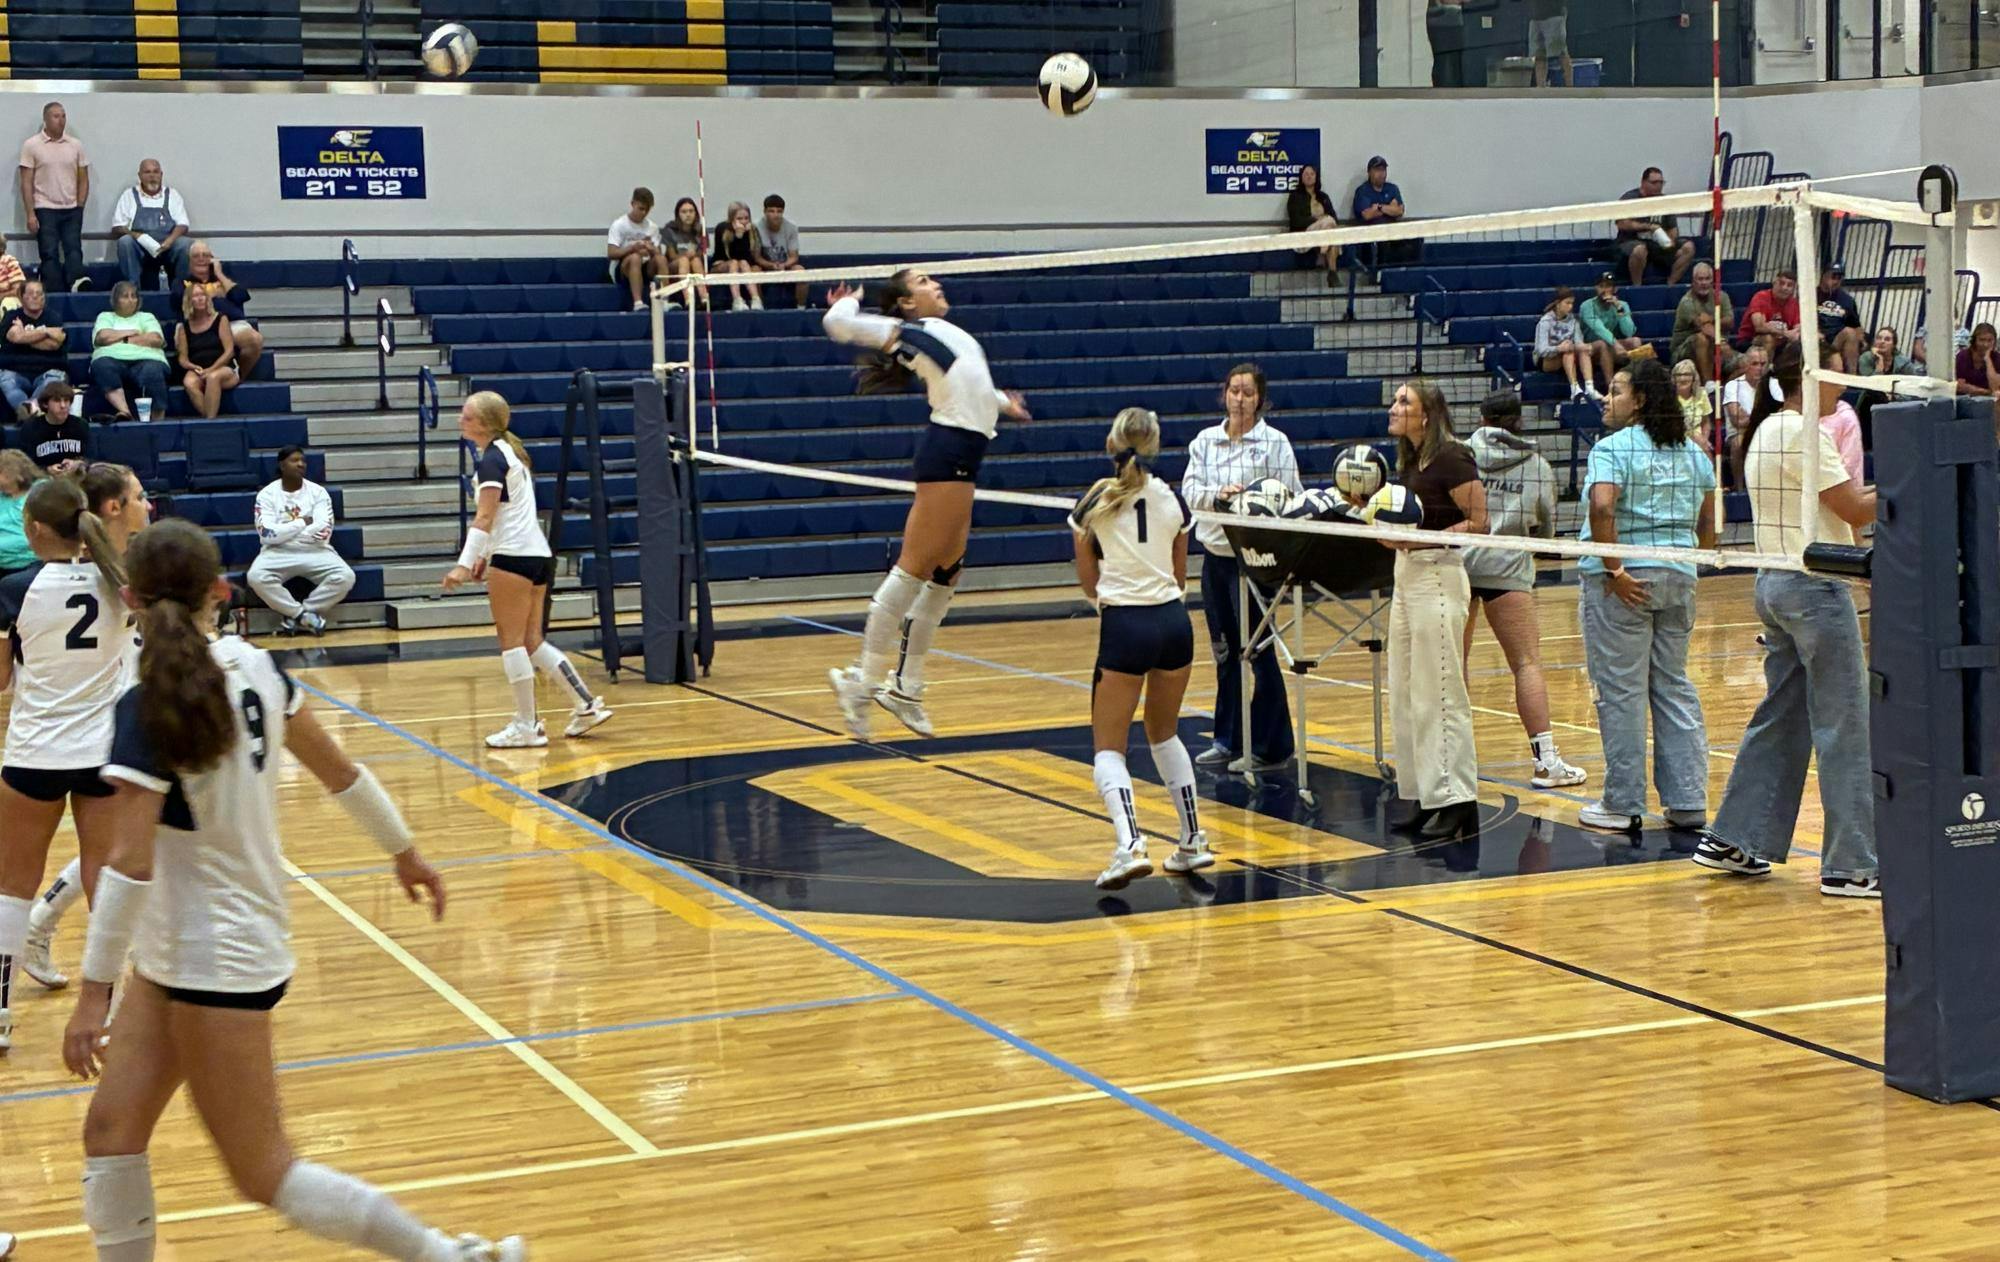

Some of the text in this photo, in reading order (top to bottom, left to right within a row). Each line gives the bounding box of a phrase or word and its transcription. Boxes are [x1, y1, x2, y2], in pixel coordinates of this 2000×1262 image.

[319, 150, 385, 164] DELTA
[1237, 150, 1289, 162] DELTA
[286, 167, 419, 178] SEASON TICKETS
[1211, 164, 1305, 175] SEASON TICKE
[305, 180, 336, 196] 21
[367, 180, 402, 196] 52
[1226, 176, 1250, 191] 21
[1274, 176, 1301, 191] 52
[1133, 497, 1148, 544] 1
[65, 592, 99, 651] 2
